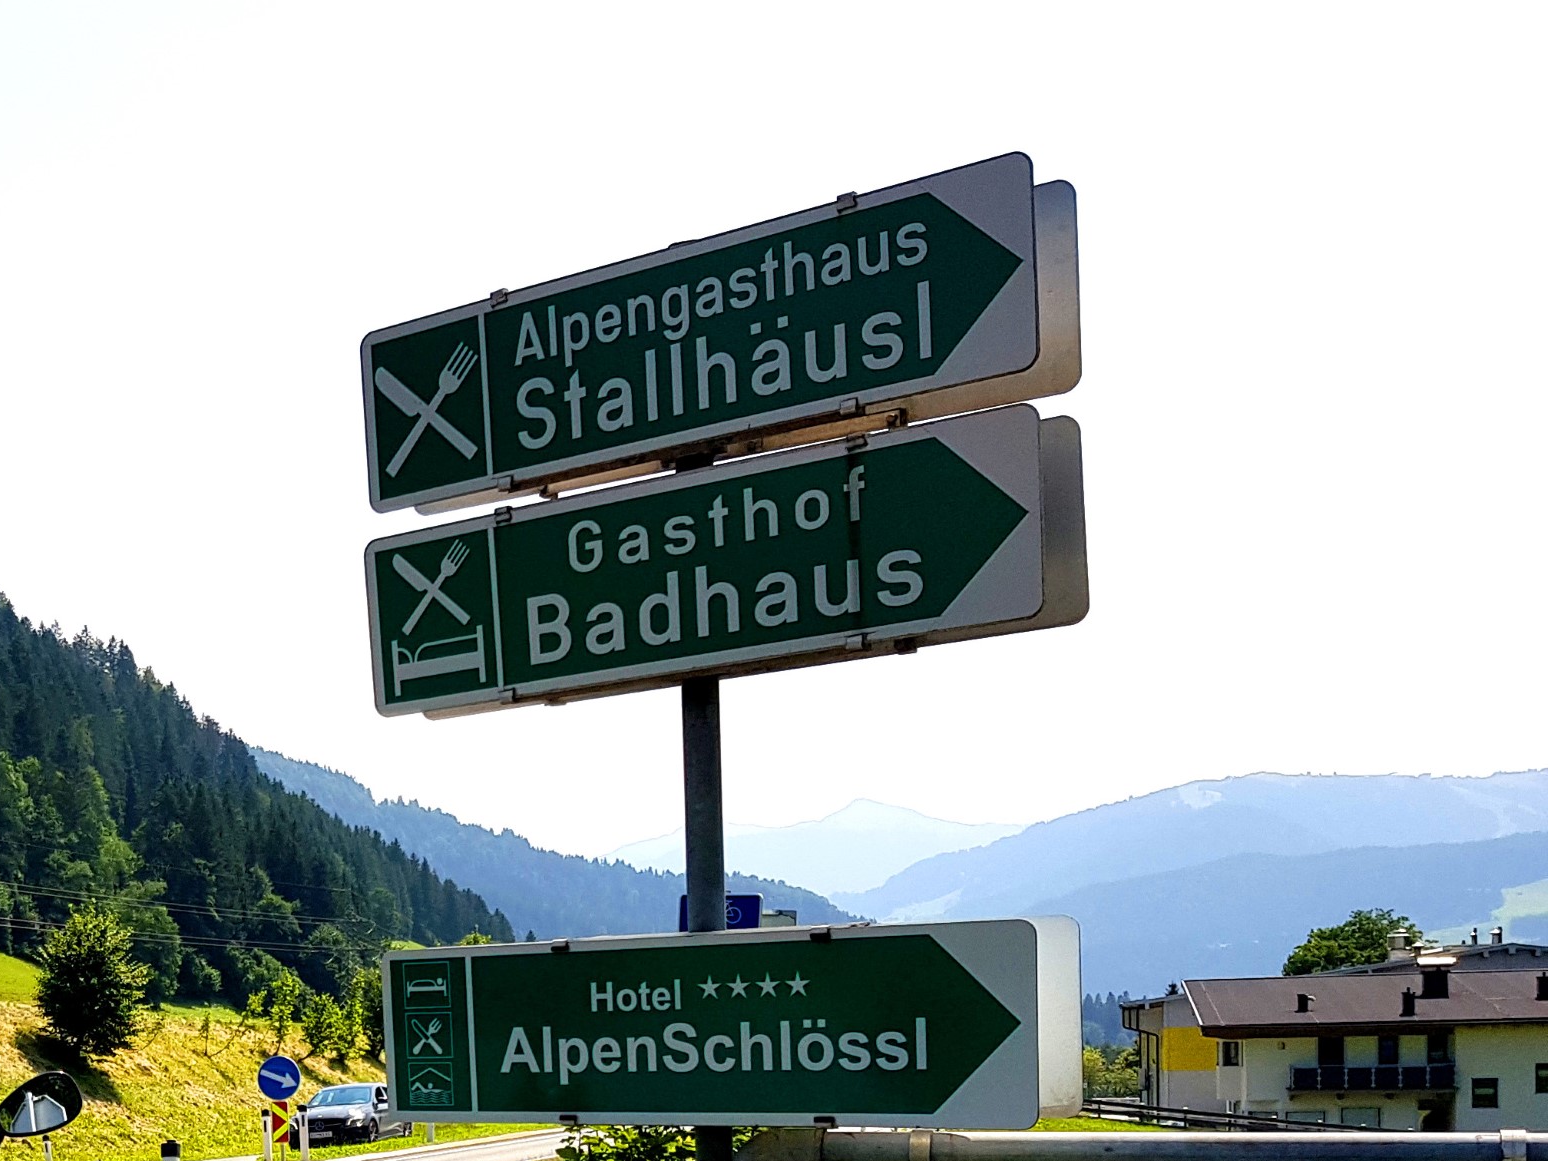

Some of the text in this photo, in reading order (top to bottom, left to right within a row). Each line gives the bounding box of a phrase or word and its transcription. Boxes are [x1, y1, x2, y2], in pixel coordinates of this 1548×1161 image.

[513, 221, 929, 367] Alpengasthaus
[515, 281, 934, 450] Stallhäusl
[567, 465, 866, 573] Gasthof
[526, 549, 924, 666] Badhaus
[500, 1017, 927, 1084] AlpenSchlössl
[590, 978, 681, 1013] Hotel
